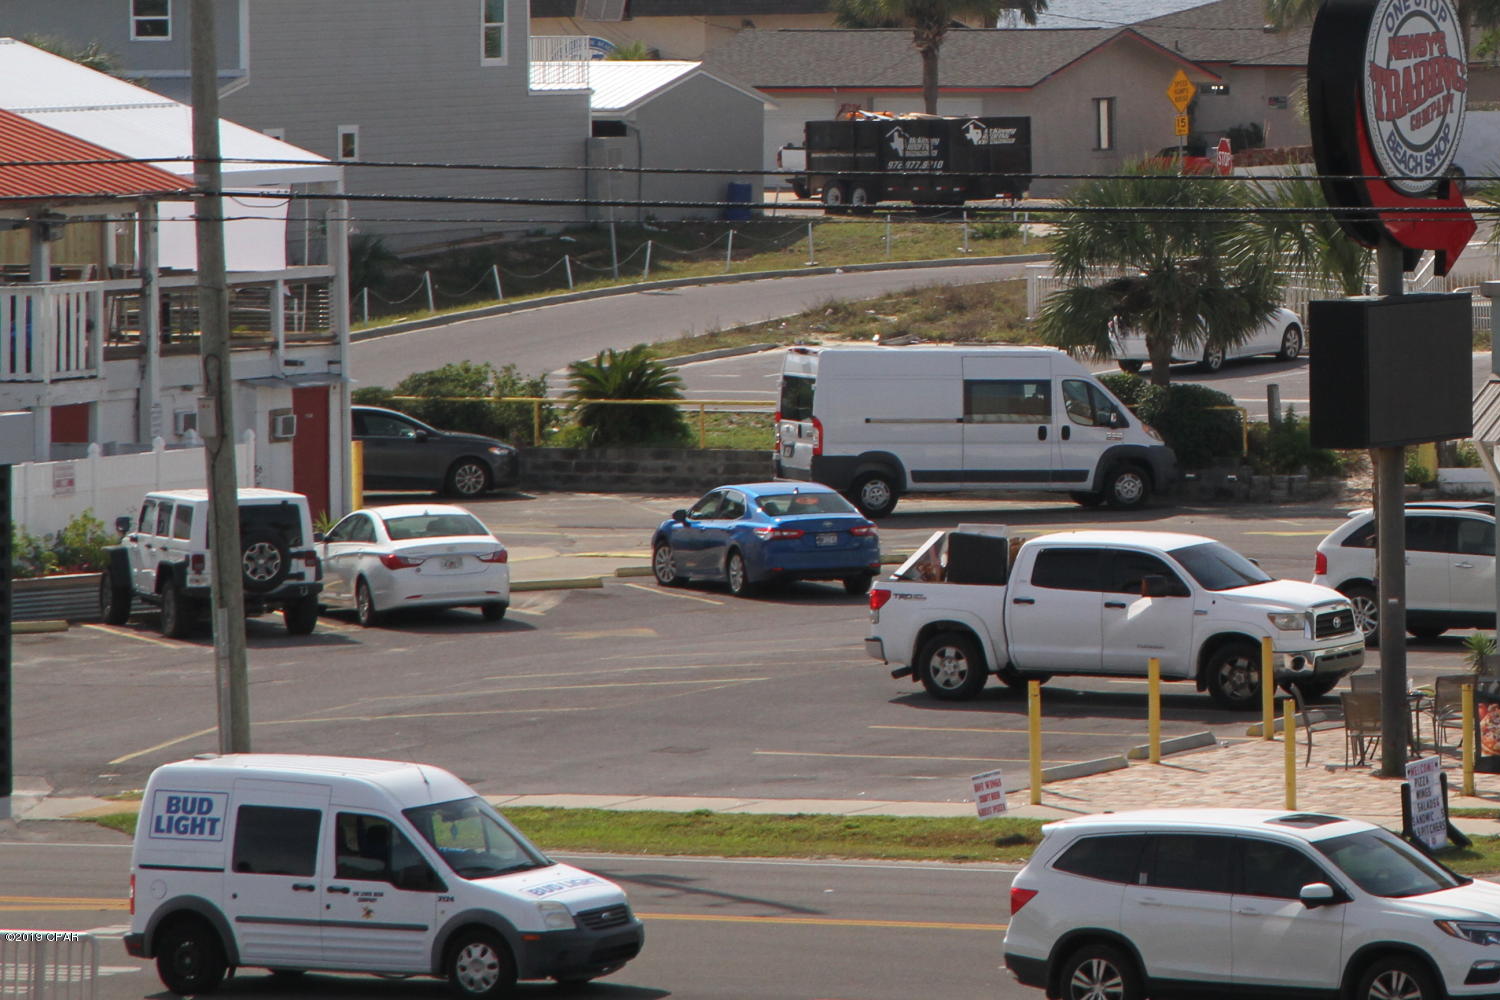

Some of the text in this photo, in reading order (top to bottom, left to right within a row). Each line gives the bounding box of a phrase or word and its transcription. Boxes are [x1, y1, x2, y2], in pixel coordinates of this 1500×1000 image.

[1369, 55, 1467, 122] TRADING
[1410, 93, 1454, 132] COMPANY
[1177, 118, 1186, 128] 15
[1386, 123, 1451, 174] BEACH SHOP
[1218, 151, 1231, 167] STOP
[1414, 776, 1429, 788] PIZZA
[166, 795, 213, 815] BUD
[154, 815, 221, 835] LIGHT
